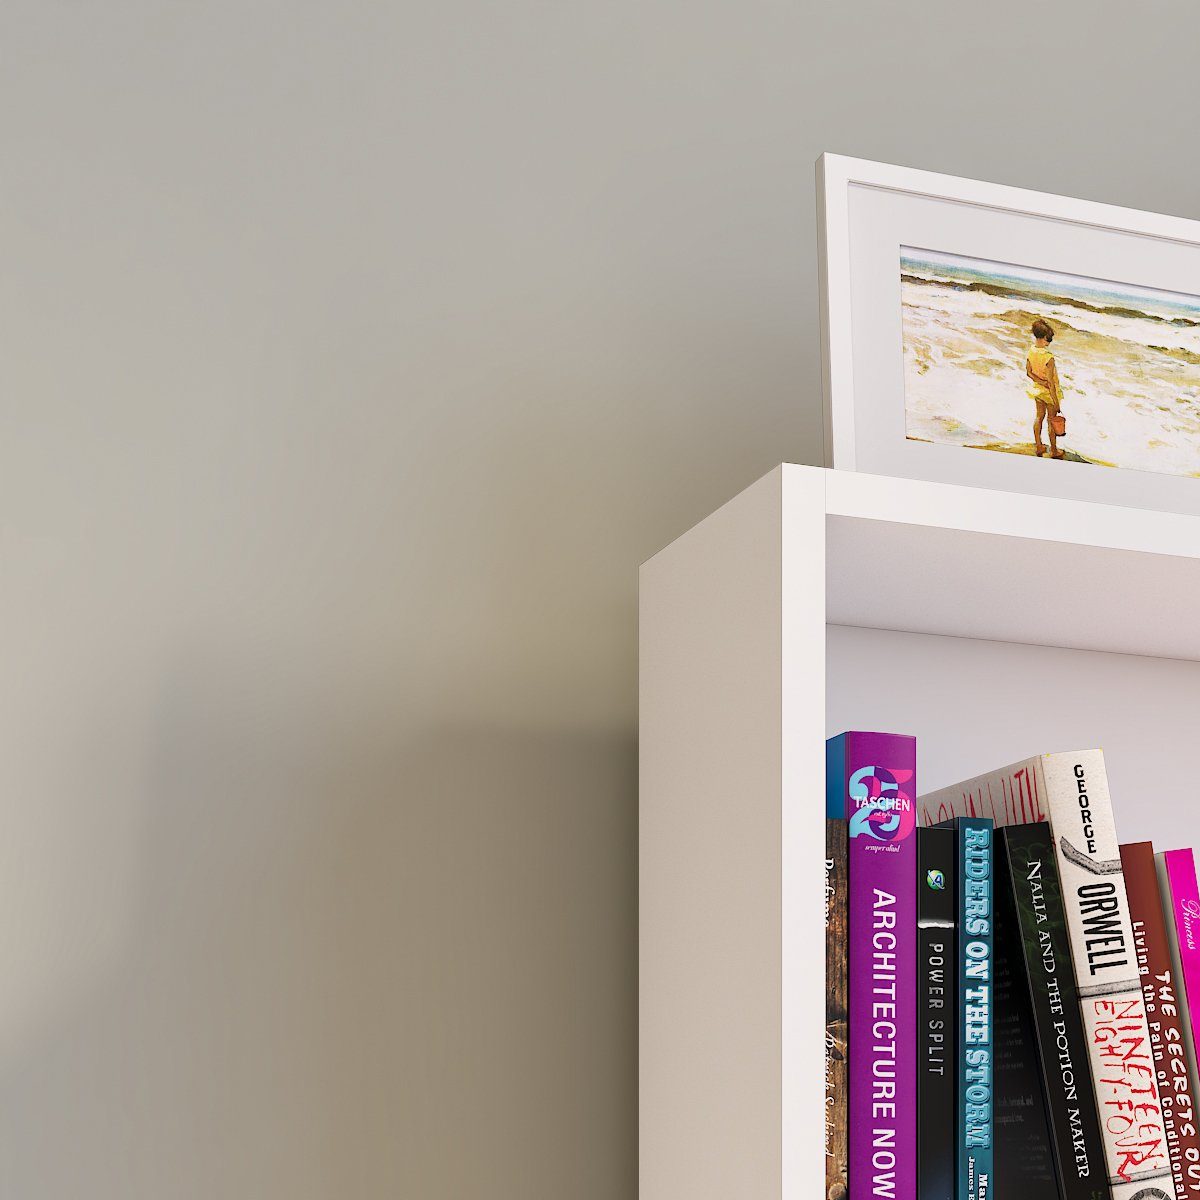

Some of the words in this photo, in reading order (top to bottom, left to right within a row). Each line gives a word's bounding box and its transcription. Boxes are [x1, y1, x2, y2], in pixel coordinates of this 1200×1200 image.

[853, 796, 911, 812] TASCHEN
[1073, 764, 1098, 854] GEORGE
[964, 827, 991, 936] RIDERS
[1026, 858, 1049, 925] NALIA
[1038, 930, 1056, 973] AND
[1077, 882, 1129, 976] ORWELL
[1132, 920, 1150, 975] Living
[1180, 898, 1200, 950] Princess
[929, 943, 944, 1009] POWER
[964, 940, 990, 982] ON
[1155, 970, 1177, 1017] THE
[872, 888, 897, 1118] ARCHITECTURE
[965, 985, 990, 1044] THE
[1047, 979, 1064, 1015] THE
[1143, 984, 1156, 1013] the
[929, 1020, 944, 1076] SPLIT
[1053, 1020, 1077, 1101] POTION
[1149, 1021, 1166, 1061] Pain
[965, 1048, 991, 1149] STORM
[1094, 1000, 1142, 1182] EIGHTY-FOUR
[1114, 1000, 1165, 1162] NINETEEN
[1157, 1070, 1170, 1087] of
[1164, 1027, 1196, 1137] SECRETS
[1067, 1108, 1090, 1178] MAKER
[1161, 1097, 1189, 1200] Conditional
